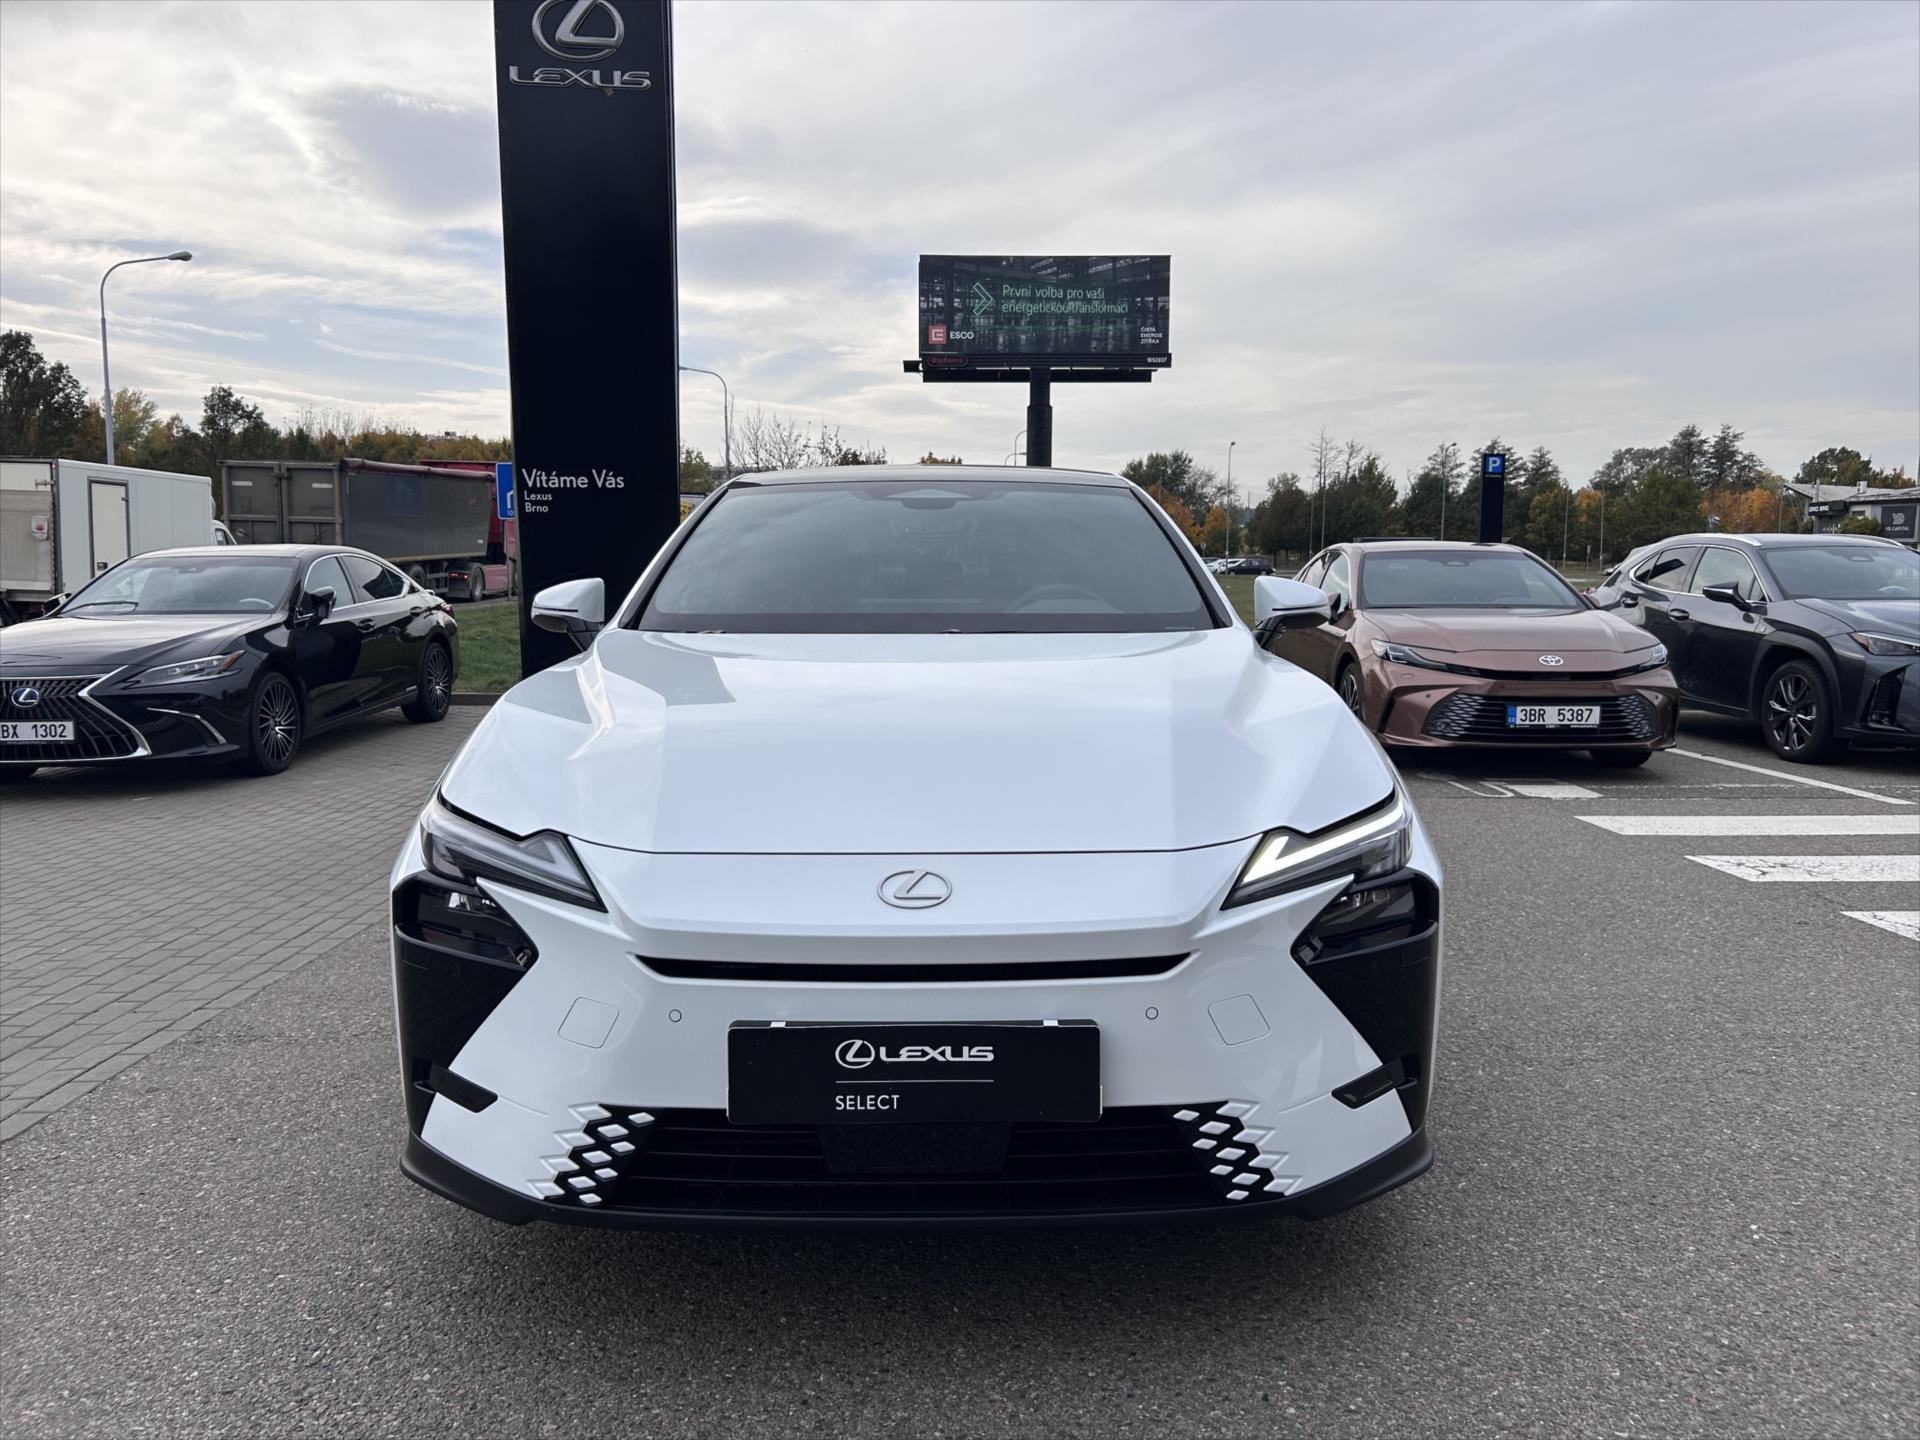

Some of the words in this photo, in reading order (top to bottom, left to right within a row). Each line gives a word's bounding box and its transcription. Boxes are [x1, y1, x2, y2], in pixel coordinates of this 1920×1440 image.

[509, 65, 652, 91] LEXUS
[1002, 284, 1032, 297] První
[1035, 286, 1063, 298] volba
[1067, 289, 1083, 301] pro
[1086, 287, 1105, 299] vaší
[1002, 300, 1068, 315] energetickou
[1069, 301, 1128, 313] transformaci
[949, 331, 975, 339] ESCO
[1488, 457, 1500, 472] P
[521, 468, 589, 488] Vítáme
[592, 468, 625, 488] Vás
[524, 490, 553, 501] Lexus
[525, 502, 549, 513] Brno
[1519, 708, 1546, 722] 3BR
[1557, 708, 1593, 722] 5387
[1, 724, 19, 739] BX
[31, 724, 67, 738] 1302
[880, 1045, 994, 1062] LEXUS
[834, 1094, 900, 1111] SELECT
